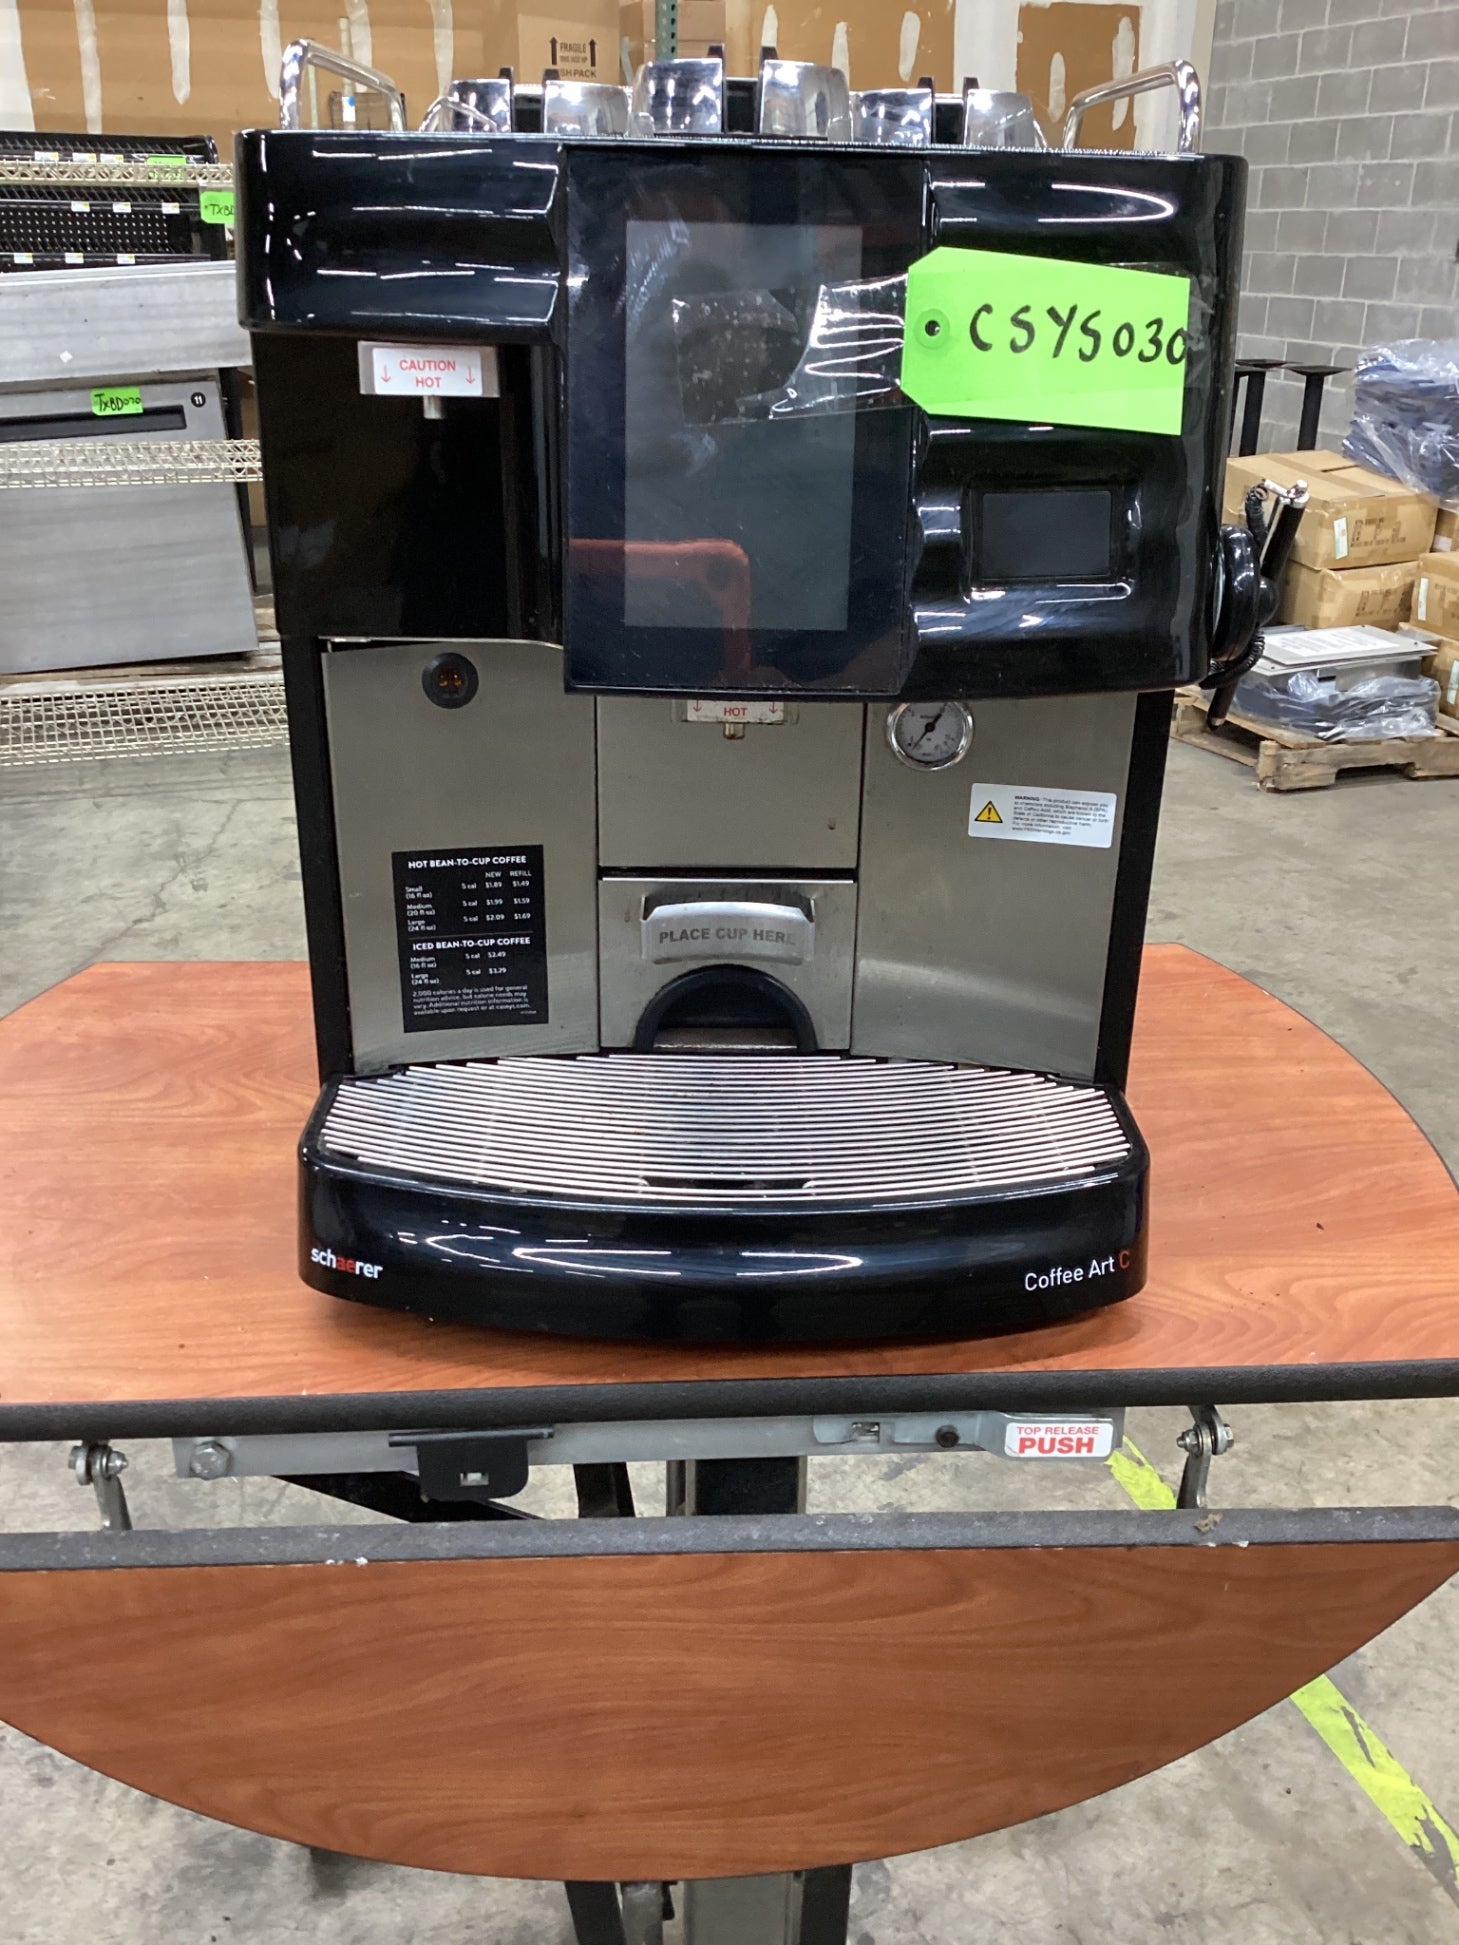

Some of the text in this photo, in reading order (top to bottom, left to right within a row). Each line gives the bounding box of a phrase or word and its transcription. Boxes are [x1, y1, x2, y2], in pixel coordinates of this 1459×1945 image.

[560, 42, 586, 53] FRAGILE
[574, 69, 596, 78] PACK
[969, 303, 1188, 365] CSYS030
[400, 360, 456, 372] CAUTION
[415, 377, 442, 388] HOT
[724, 707, 748, 716] HOT
[408, 855, 527, 869] HOT BEAN-TO-CUP COFFEE
[659, 928, 711, 943] PLACE
[715, 928, 748, 941] CUP
[413, 937, 530, 950] ICED BEAN-TO-CUP COFFEE
[310, 1248, 383, 1278] schaerer
[1024, 1250, 1130, 1291] Coffee Art C
[1016, 1426, 1100, 1435] TOP RELEASE
[1018, 1437, 1094, 1454] PUSH
